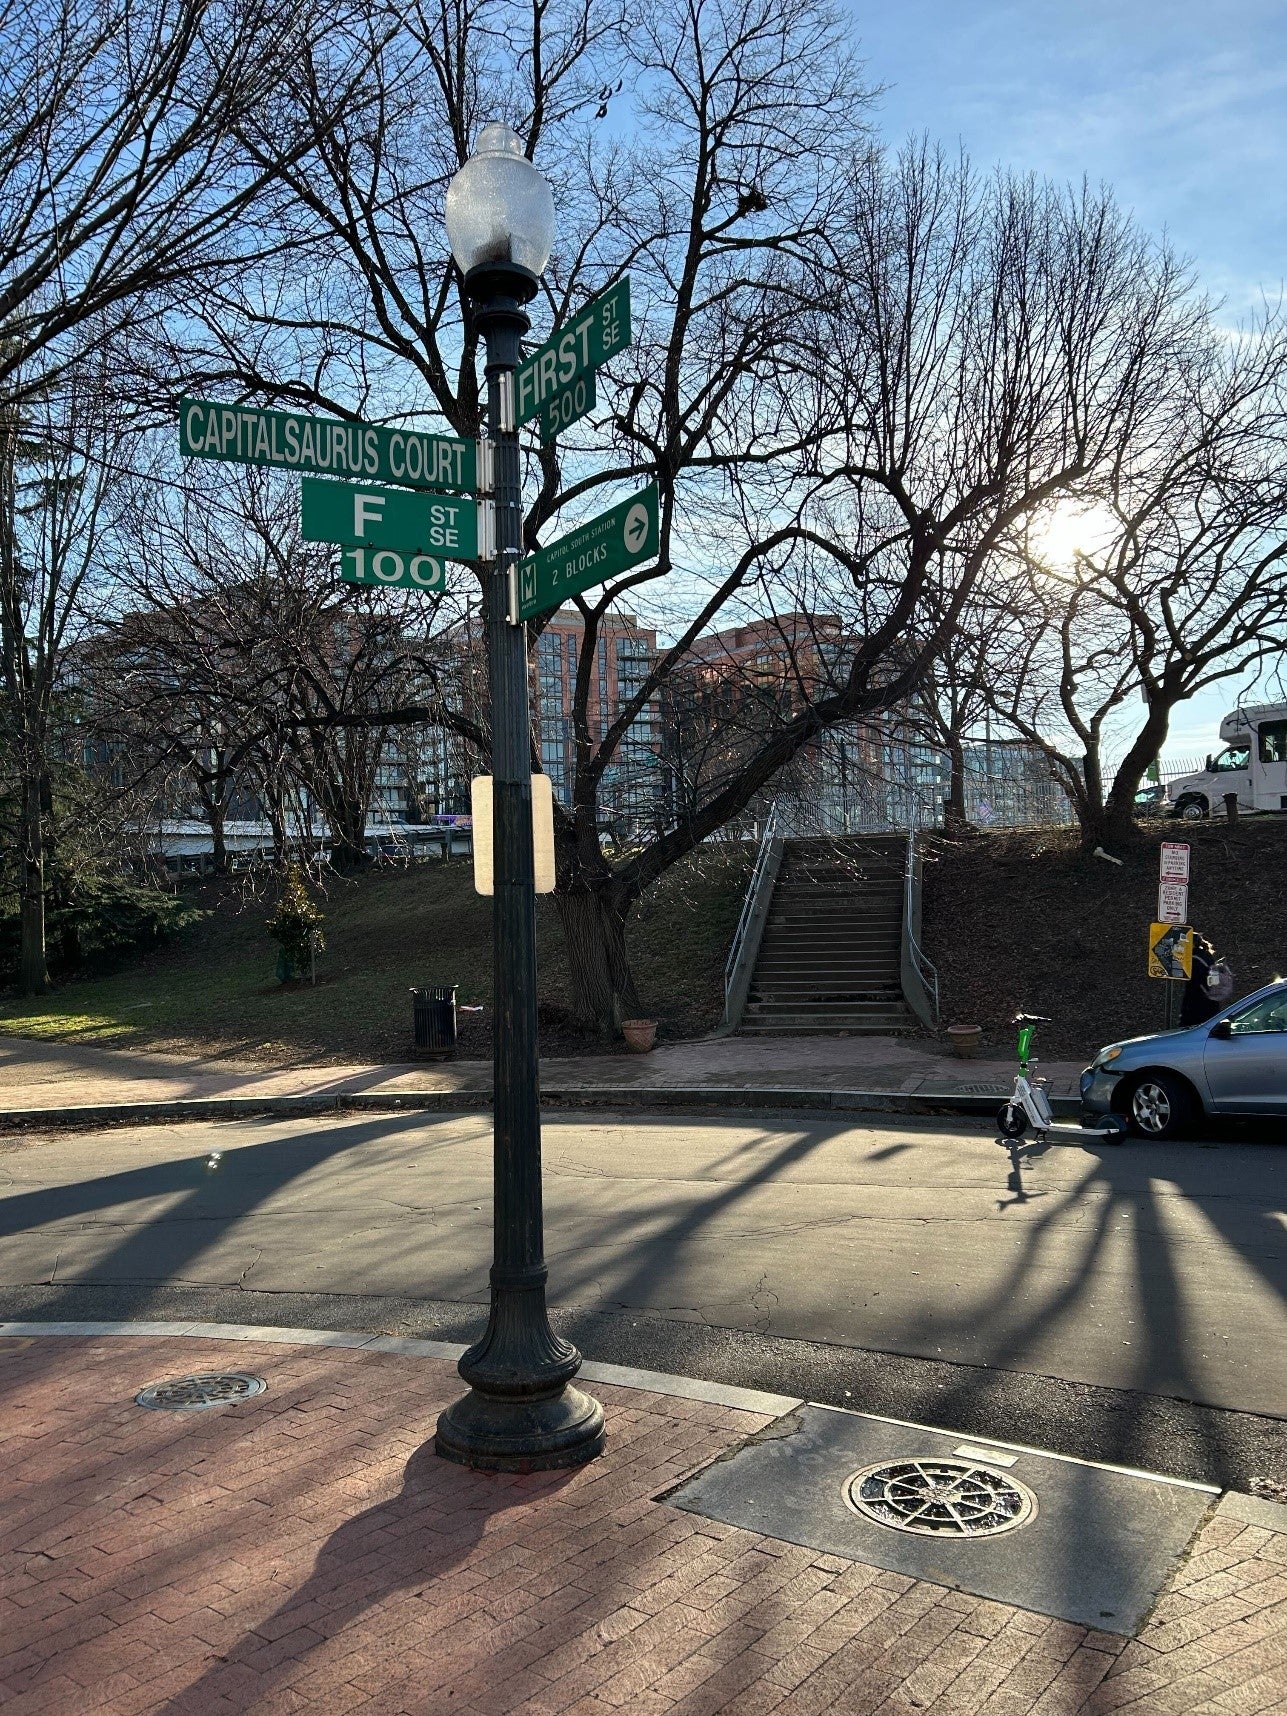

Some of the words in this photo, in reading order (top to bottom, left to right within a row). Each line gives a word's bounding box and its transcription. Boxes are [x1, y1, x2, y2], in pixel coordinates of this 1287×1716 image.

[602, 296, 618, 326] ST
[602, 320, 620, 350] SE
[519, 315, 594, 417] FIRST
[549, 380, 586, 433] 500
[186, 404, 379, 475] CAPITALSAURUS
[389, 433, 466, 485] COURT
[354, 493, 386, 537] F
[430, 505, 460, 526] ST
[429, 526, 459, 548] SE
[547, 546, 568, 563] CAPITOL
[571, 533, 590, 550] SOUTH
[591, 518, 616, 538] STATION
[346, 548, 441, 586] 100
[552, 570, 559, 586] 2
[566, 543, 607, 578] BLOCKS
